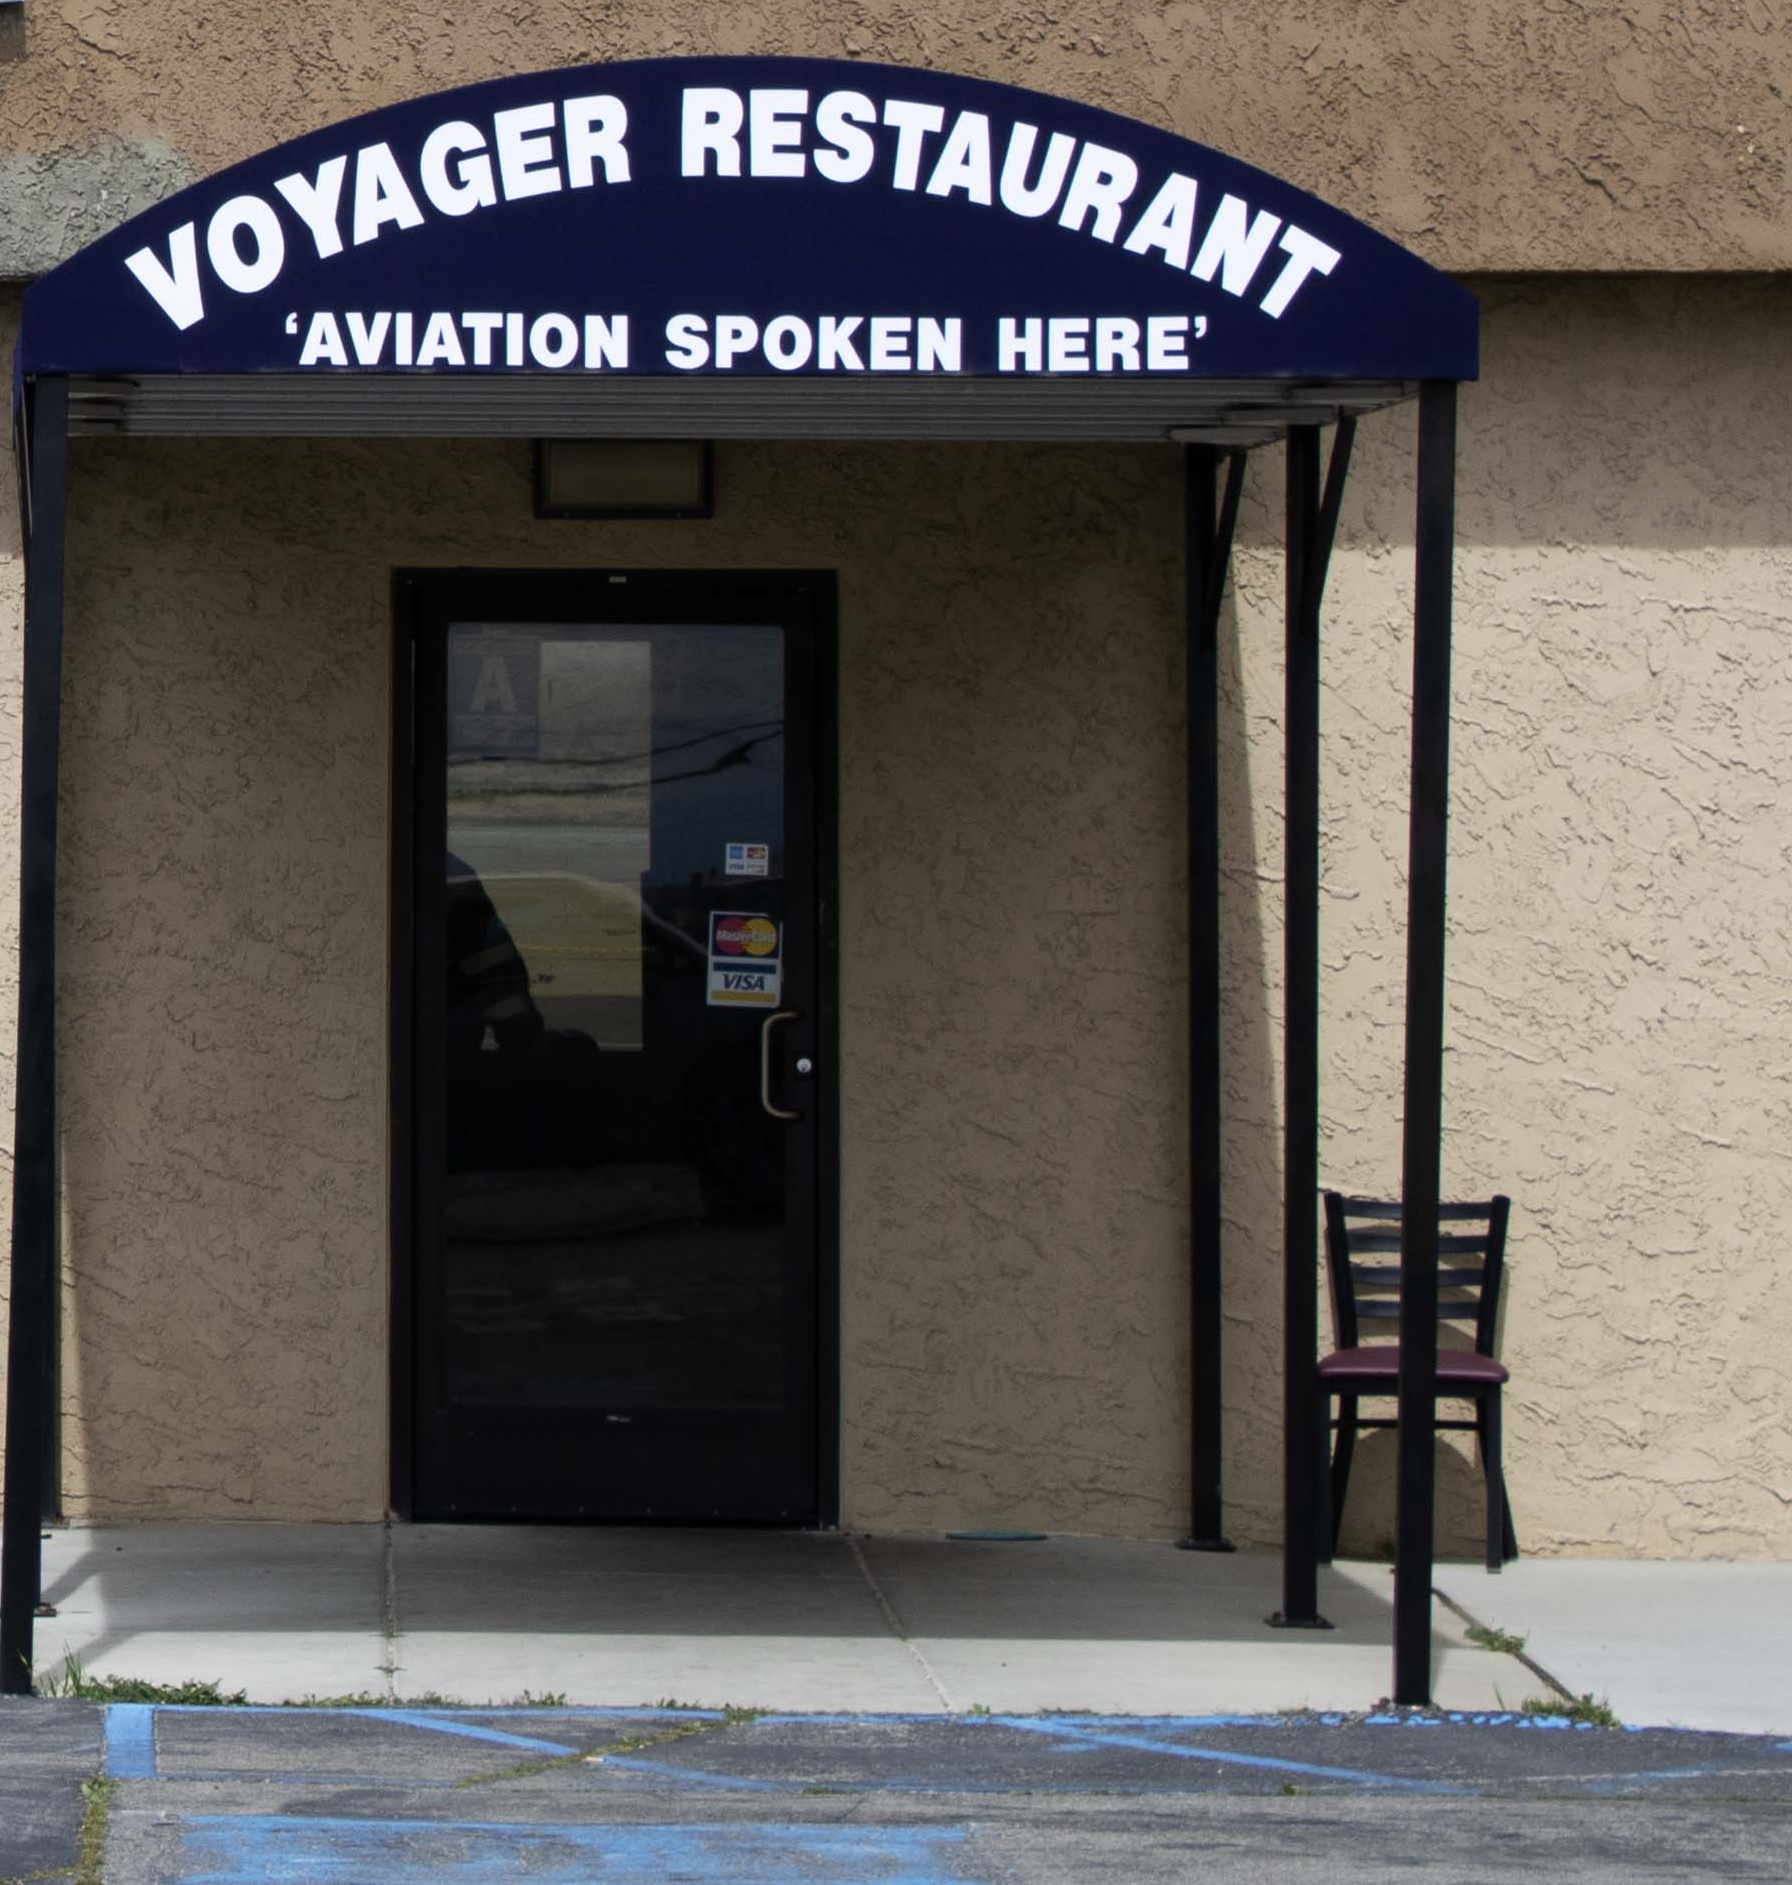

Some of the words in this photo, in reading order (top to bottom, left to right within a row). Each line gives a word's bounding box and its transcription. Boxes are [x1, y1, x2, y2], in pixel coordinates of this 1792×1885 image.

[125, 93, 631, 332] VOYAGER
[682, 87, 1343, 320] RESTAURANT
[665, 312, 962, 372] SPOKEN
[723, 973, 766, 991] VISA
